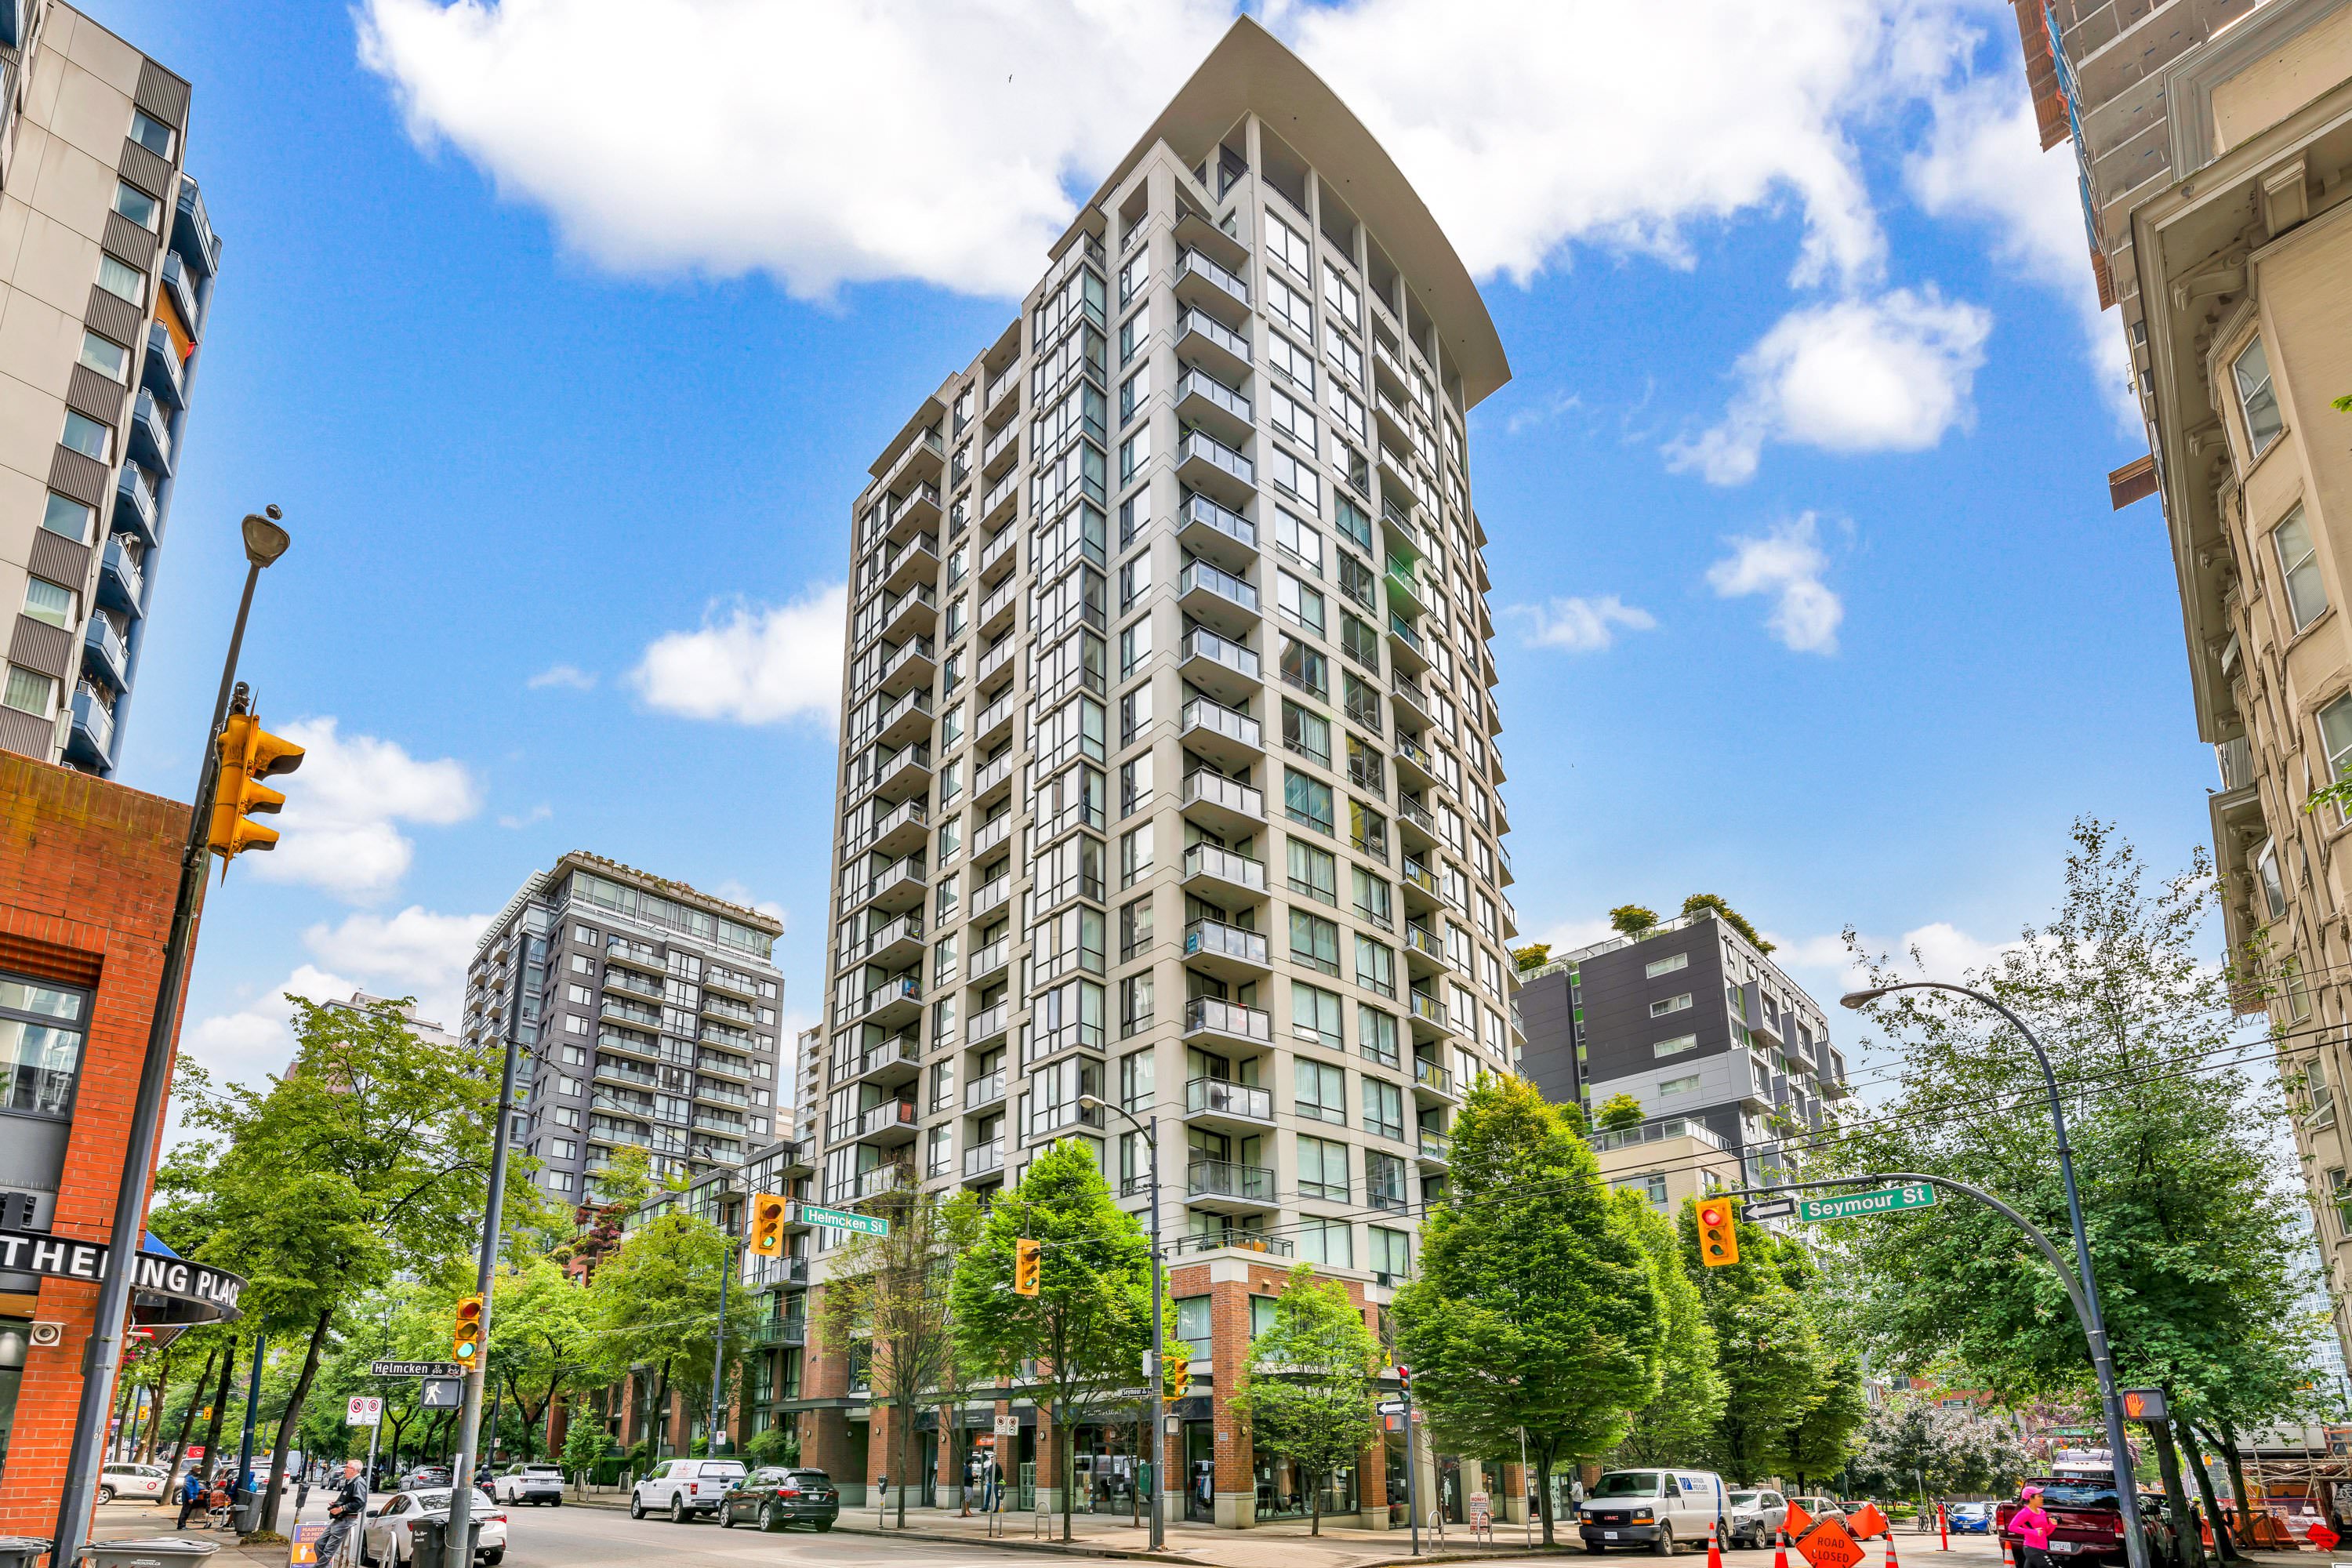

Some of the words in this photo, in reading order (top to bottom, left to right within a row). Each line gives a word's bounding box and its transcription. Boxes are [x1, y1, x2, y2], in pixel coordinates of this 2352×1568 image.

[1809, 1194, 1893, 1217] Seymour
[1902, 1188, 1926, 1203] St
[808, 1209, 866, 1229] Helmcken
[870, 1221, 883, 1232] St
[0, 1236, 187, 1292] THEING
[375, 1363, 428, 1374] Helmcken
[1123, 1388, 1142, 1396] Seymour
[1817, 1537, 1845, 1548] ROAD
[1811, 1550, 1849, 1563] CLOSED
